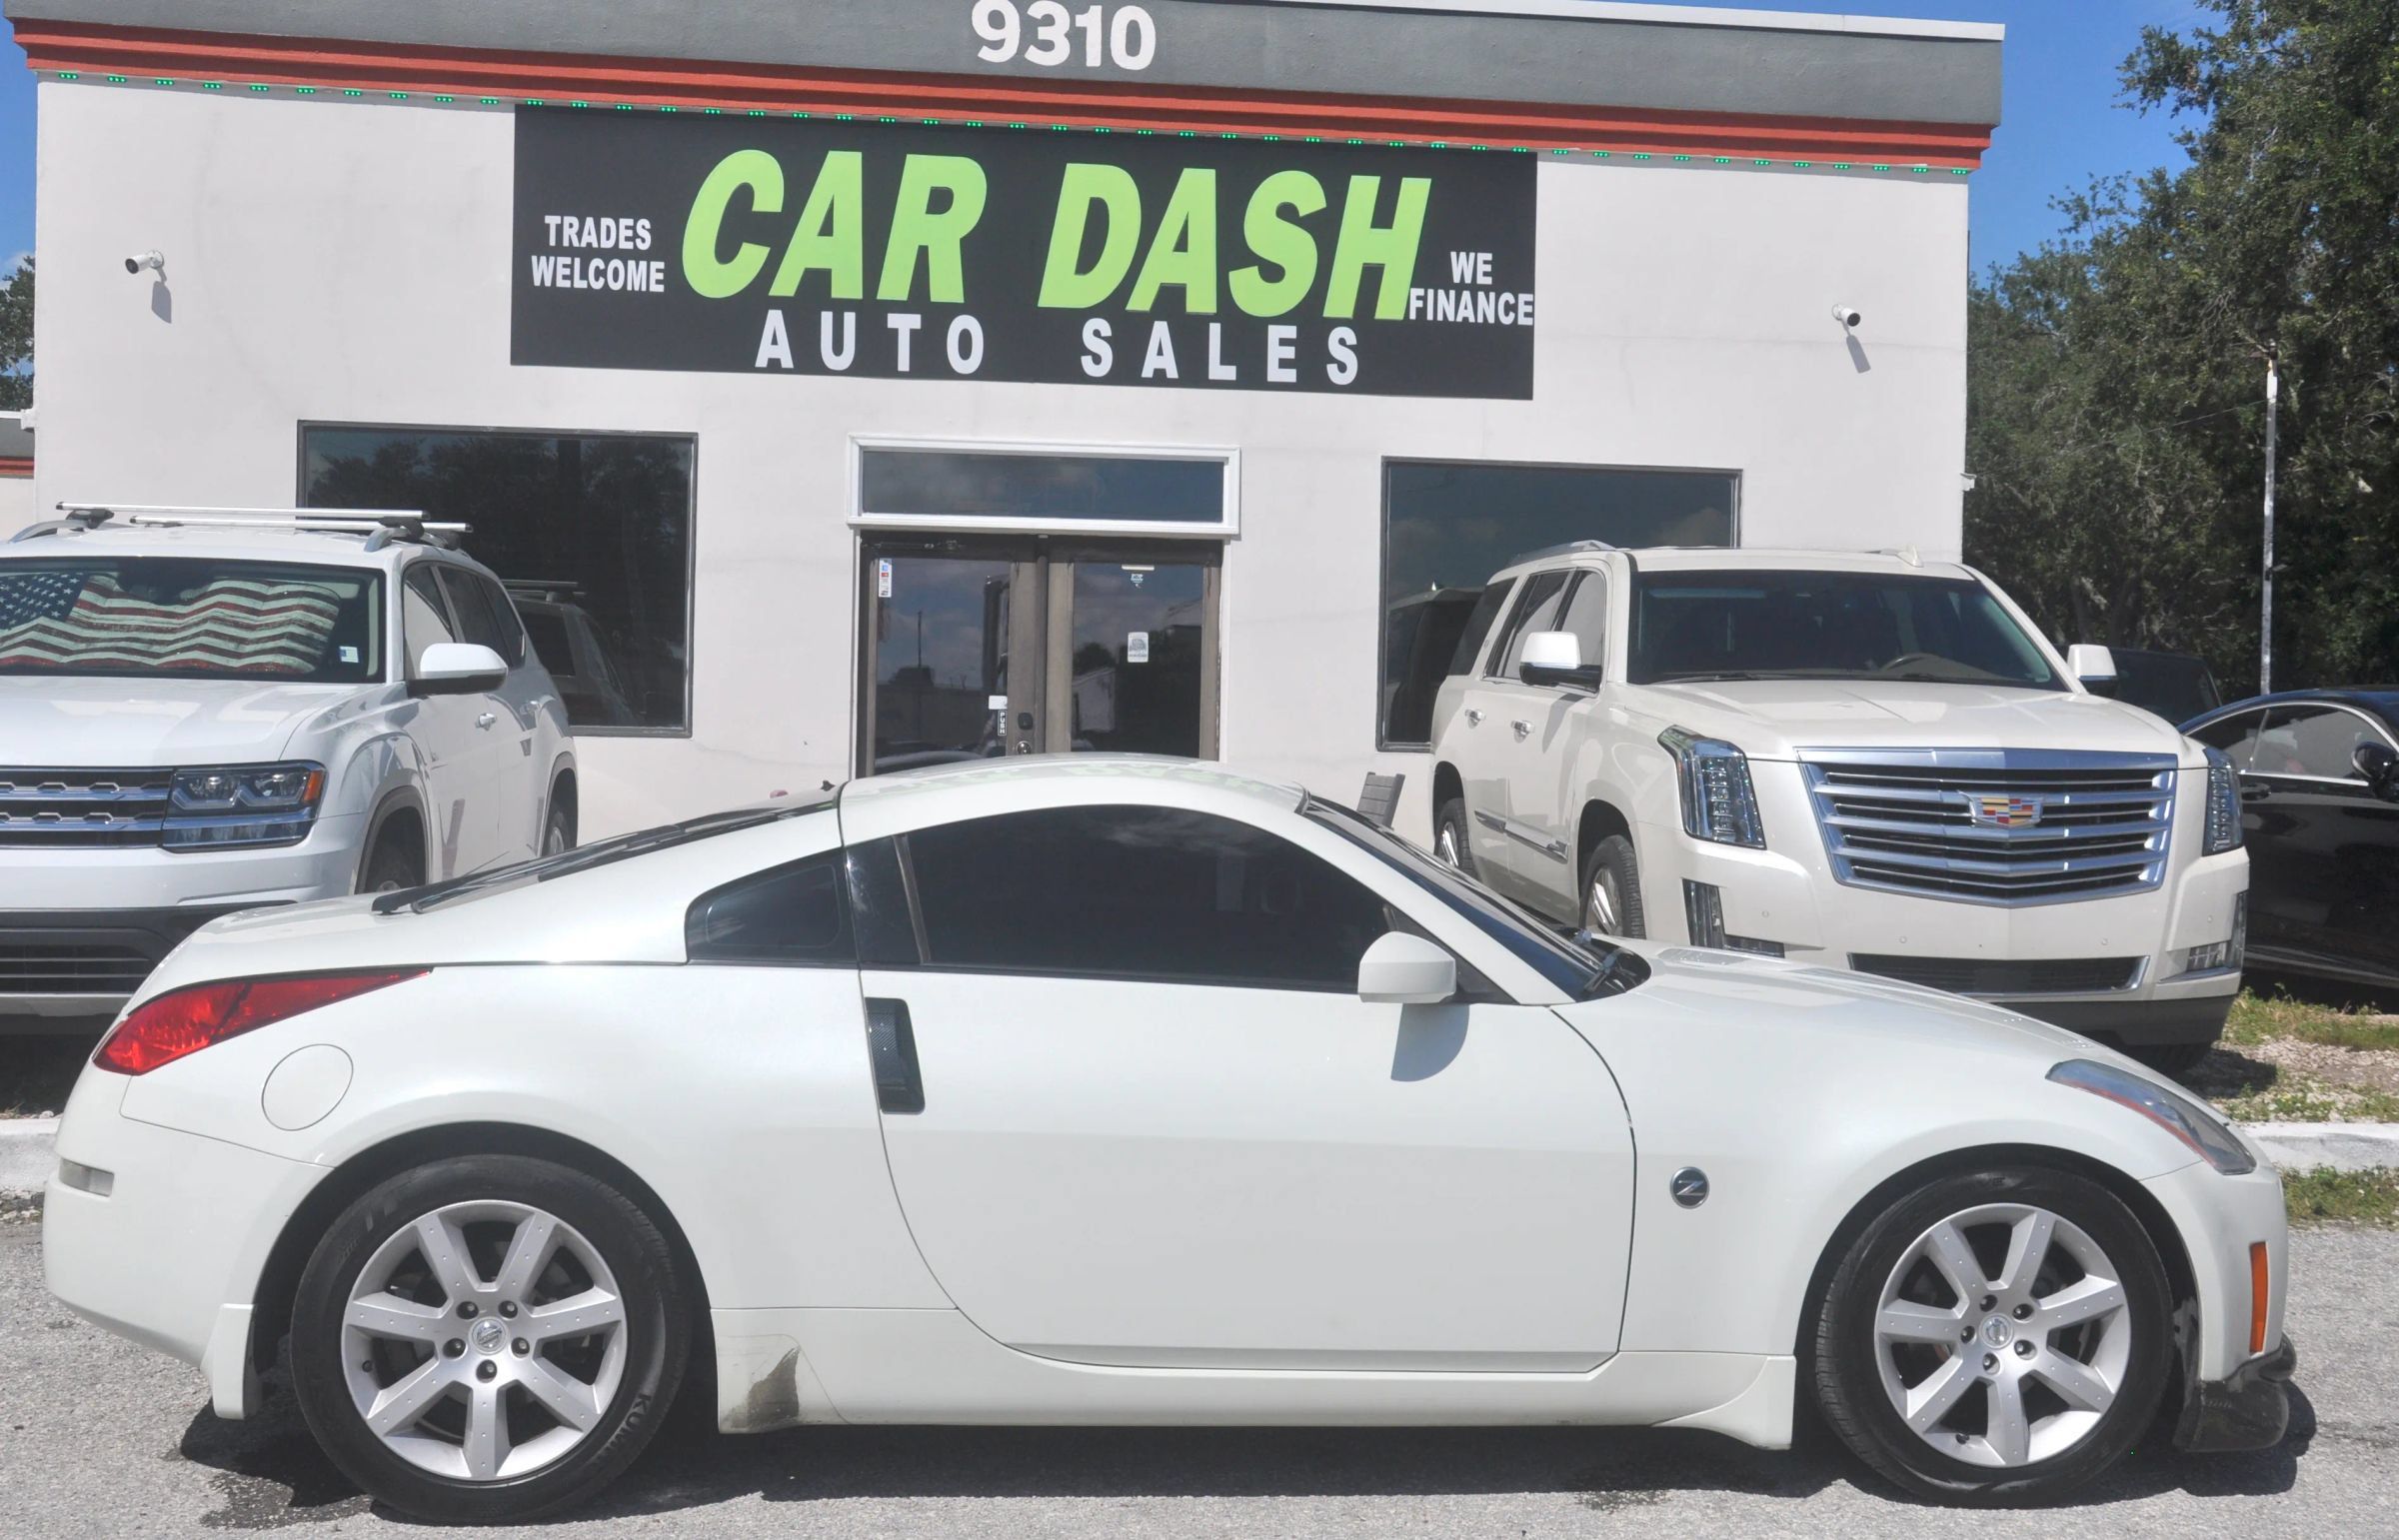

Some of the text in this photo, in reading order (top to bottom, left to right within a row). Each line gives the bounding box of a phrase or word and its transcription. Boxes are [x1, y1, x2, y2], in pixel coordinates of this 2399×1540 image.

[972, 0, 1156, 70] 9310
[545, 216, 652, 250] TRADES
[683, 149, 1430, 320] CAR DASH
[532, 256, 665, 293] WELCOME
[1450, 251, 1493, 284] WE
[1409, 288, 1534, 326] FINANCE
[755, 309, 1358, 386] AUTO SALES
